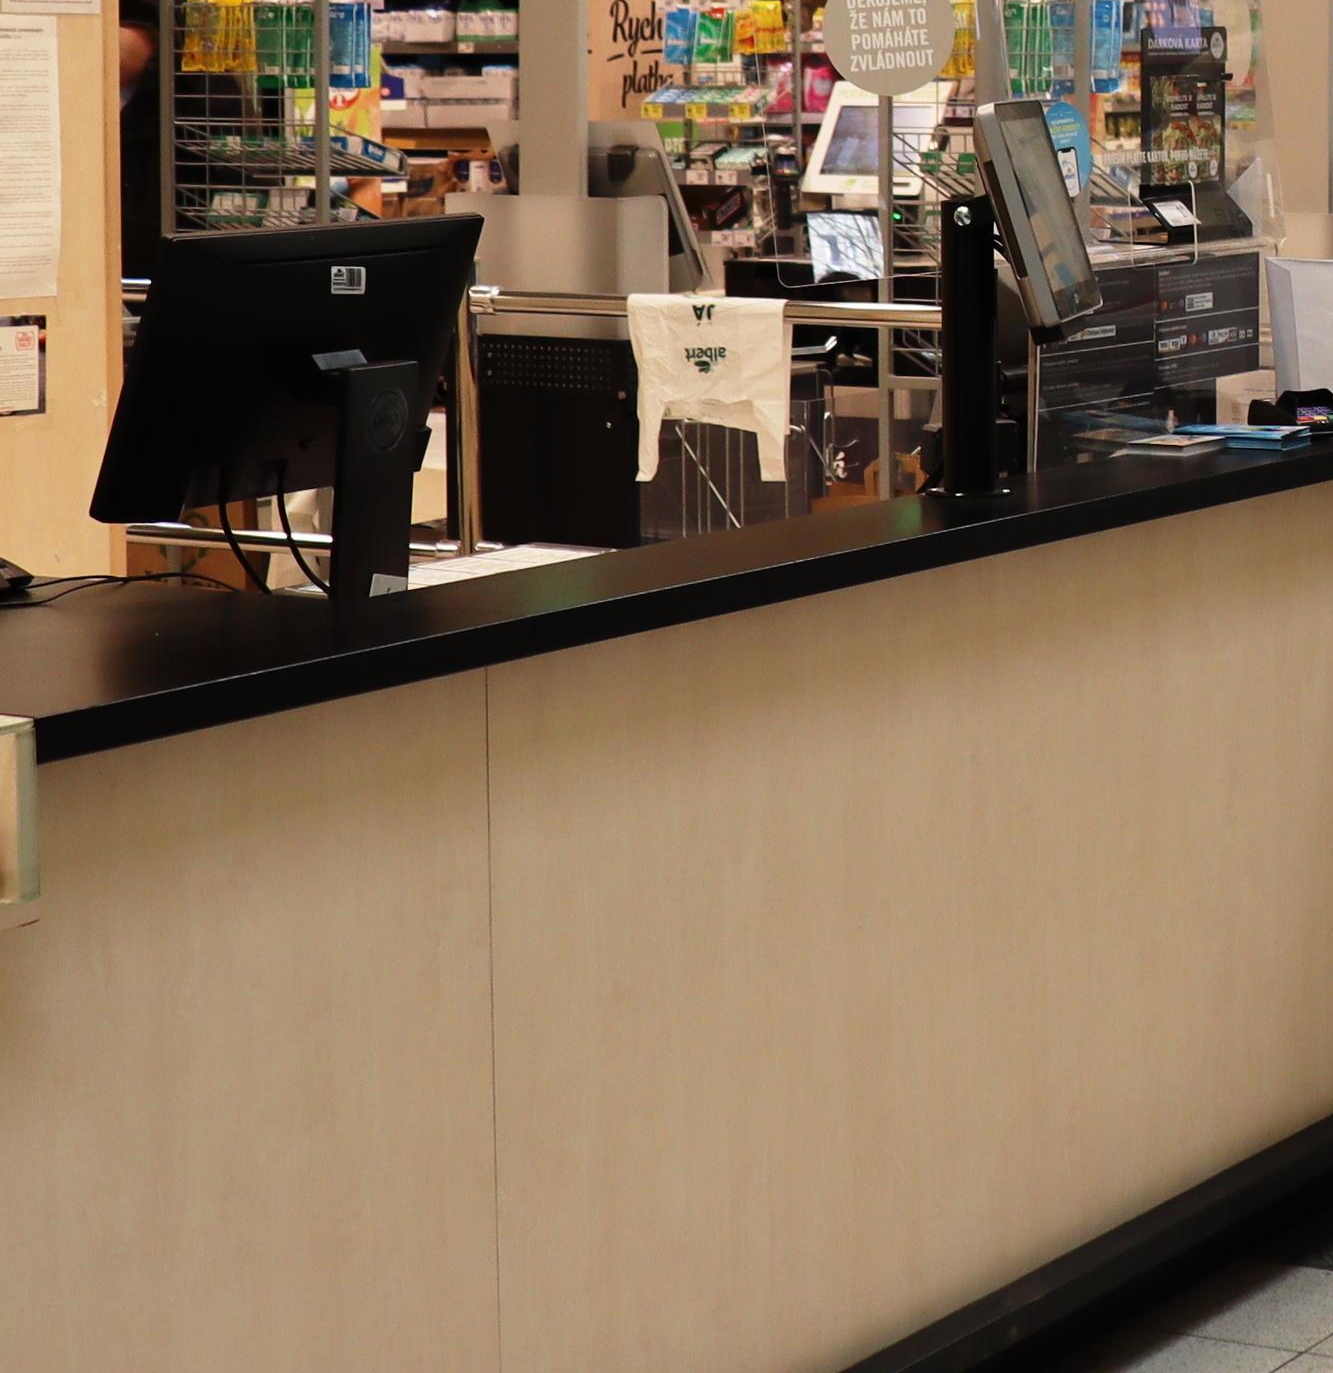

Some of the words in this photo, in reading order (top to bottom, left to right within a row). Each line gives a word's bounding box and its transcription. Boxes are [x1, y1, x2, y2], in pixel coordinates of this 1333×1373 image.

[849, 9, 868, 30] ŽE
[872, 8, 904, 29] NÁM
[908, 8, 927, 25] TO
[851, 26, 929, 51] POMÁHÁTE
[1147, 35, 1184, 49] DÁRKOVÁ
[1185, 37, 1209, 49] KARTA
[850, 49, 934, 72] ZVLÁDNOUT
[684, 346, 727, 363] albert
